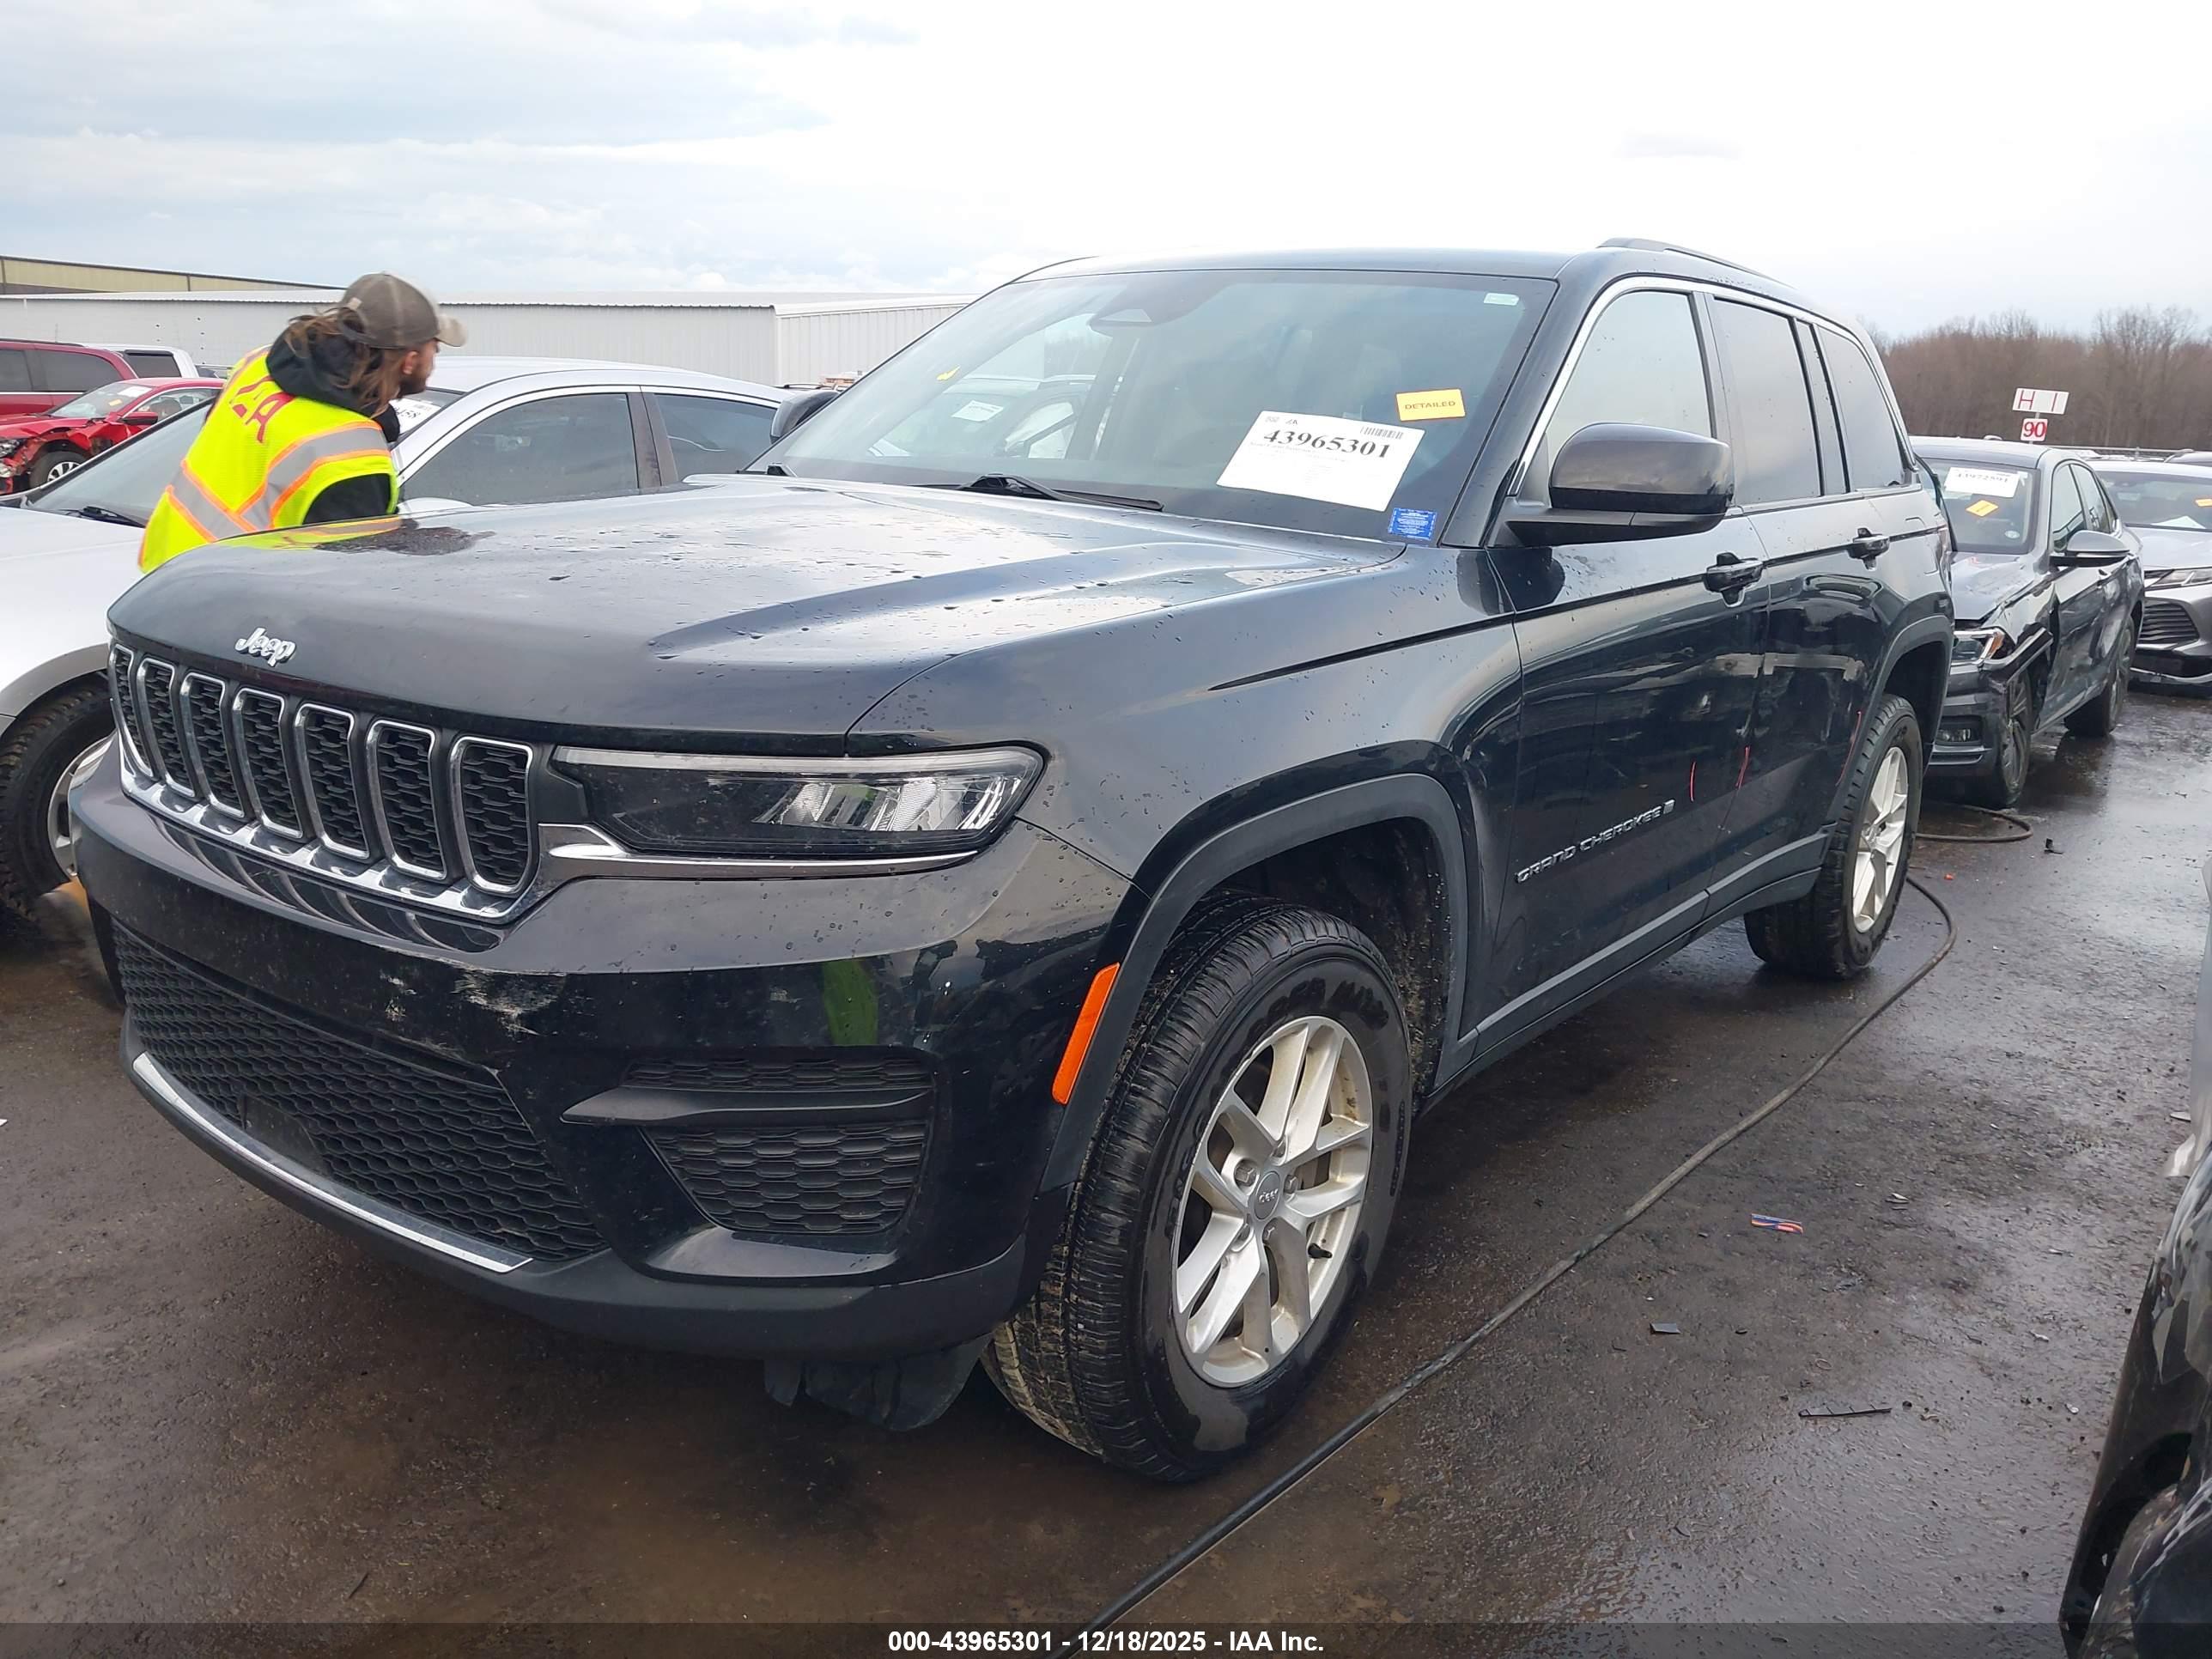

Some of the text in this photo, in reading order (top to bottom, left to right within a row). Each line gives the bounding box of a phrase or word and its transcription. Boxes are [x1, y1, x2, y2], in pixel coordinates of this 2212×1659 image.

[1405, 400, 1455, 410] DETAILED
[2017, 389, 2036, 410] H
[2023, 421, 2047, 438] 90
[1264, 429, 1390, 459] 43965301
[234, 627, 296, 666] Jeep
[1516, 805, 1662, 883] GRAND CHEROKEE
